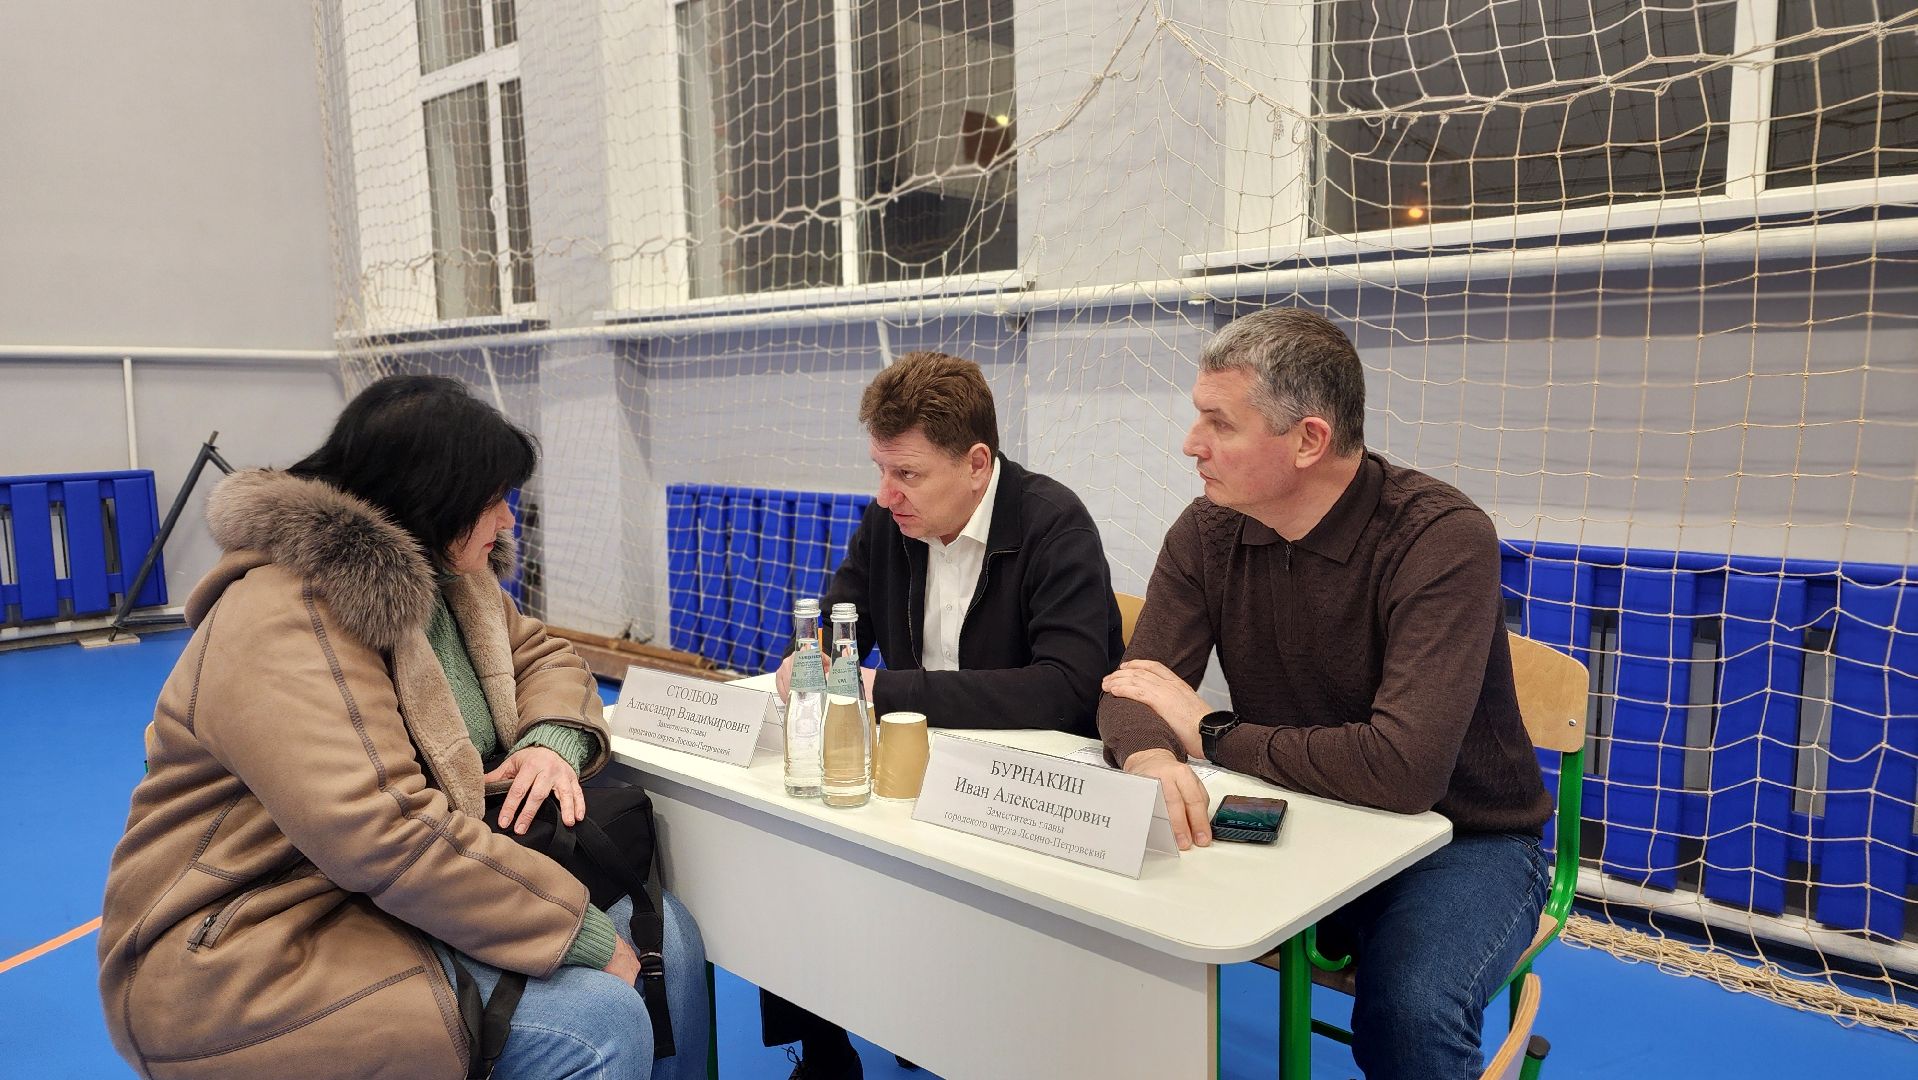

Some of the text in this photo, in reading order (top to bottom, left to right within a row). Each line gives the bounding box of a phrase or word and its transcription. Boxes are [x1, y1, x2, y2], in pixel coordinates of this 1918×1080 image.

[666, 684, 719, 706] СТОЛБОВ
[627, 697, 750, 734] Александр Владимирович
[990, 759, 1085, 795] БУРНАКИН
[954, 776, 1112, 829] Иван Александрович
[985, 806, 1064, 833] Заместитель главы
[943, 810, 1107, 860] городского округа Лосино-Петровский
